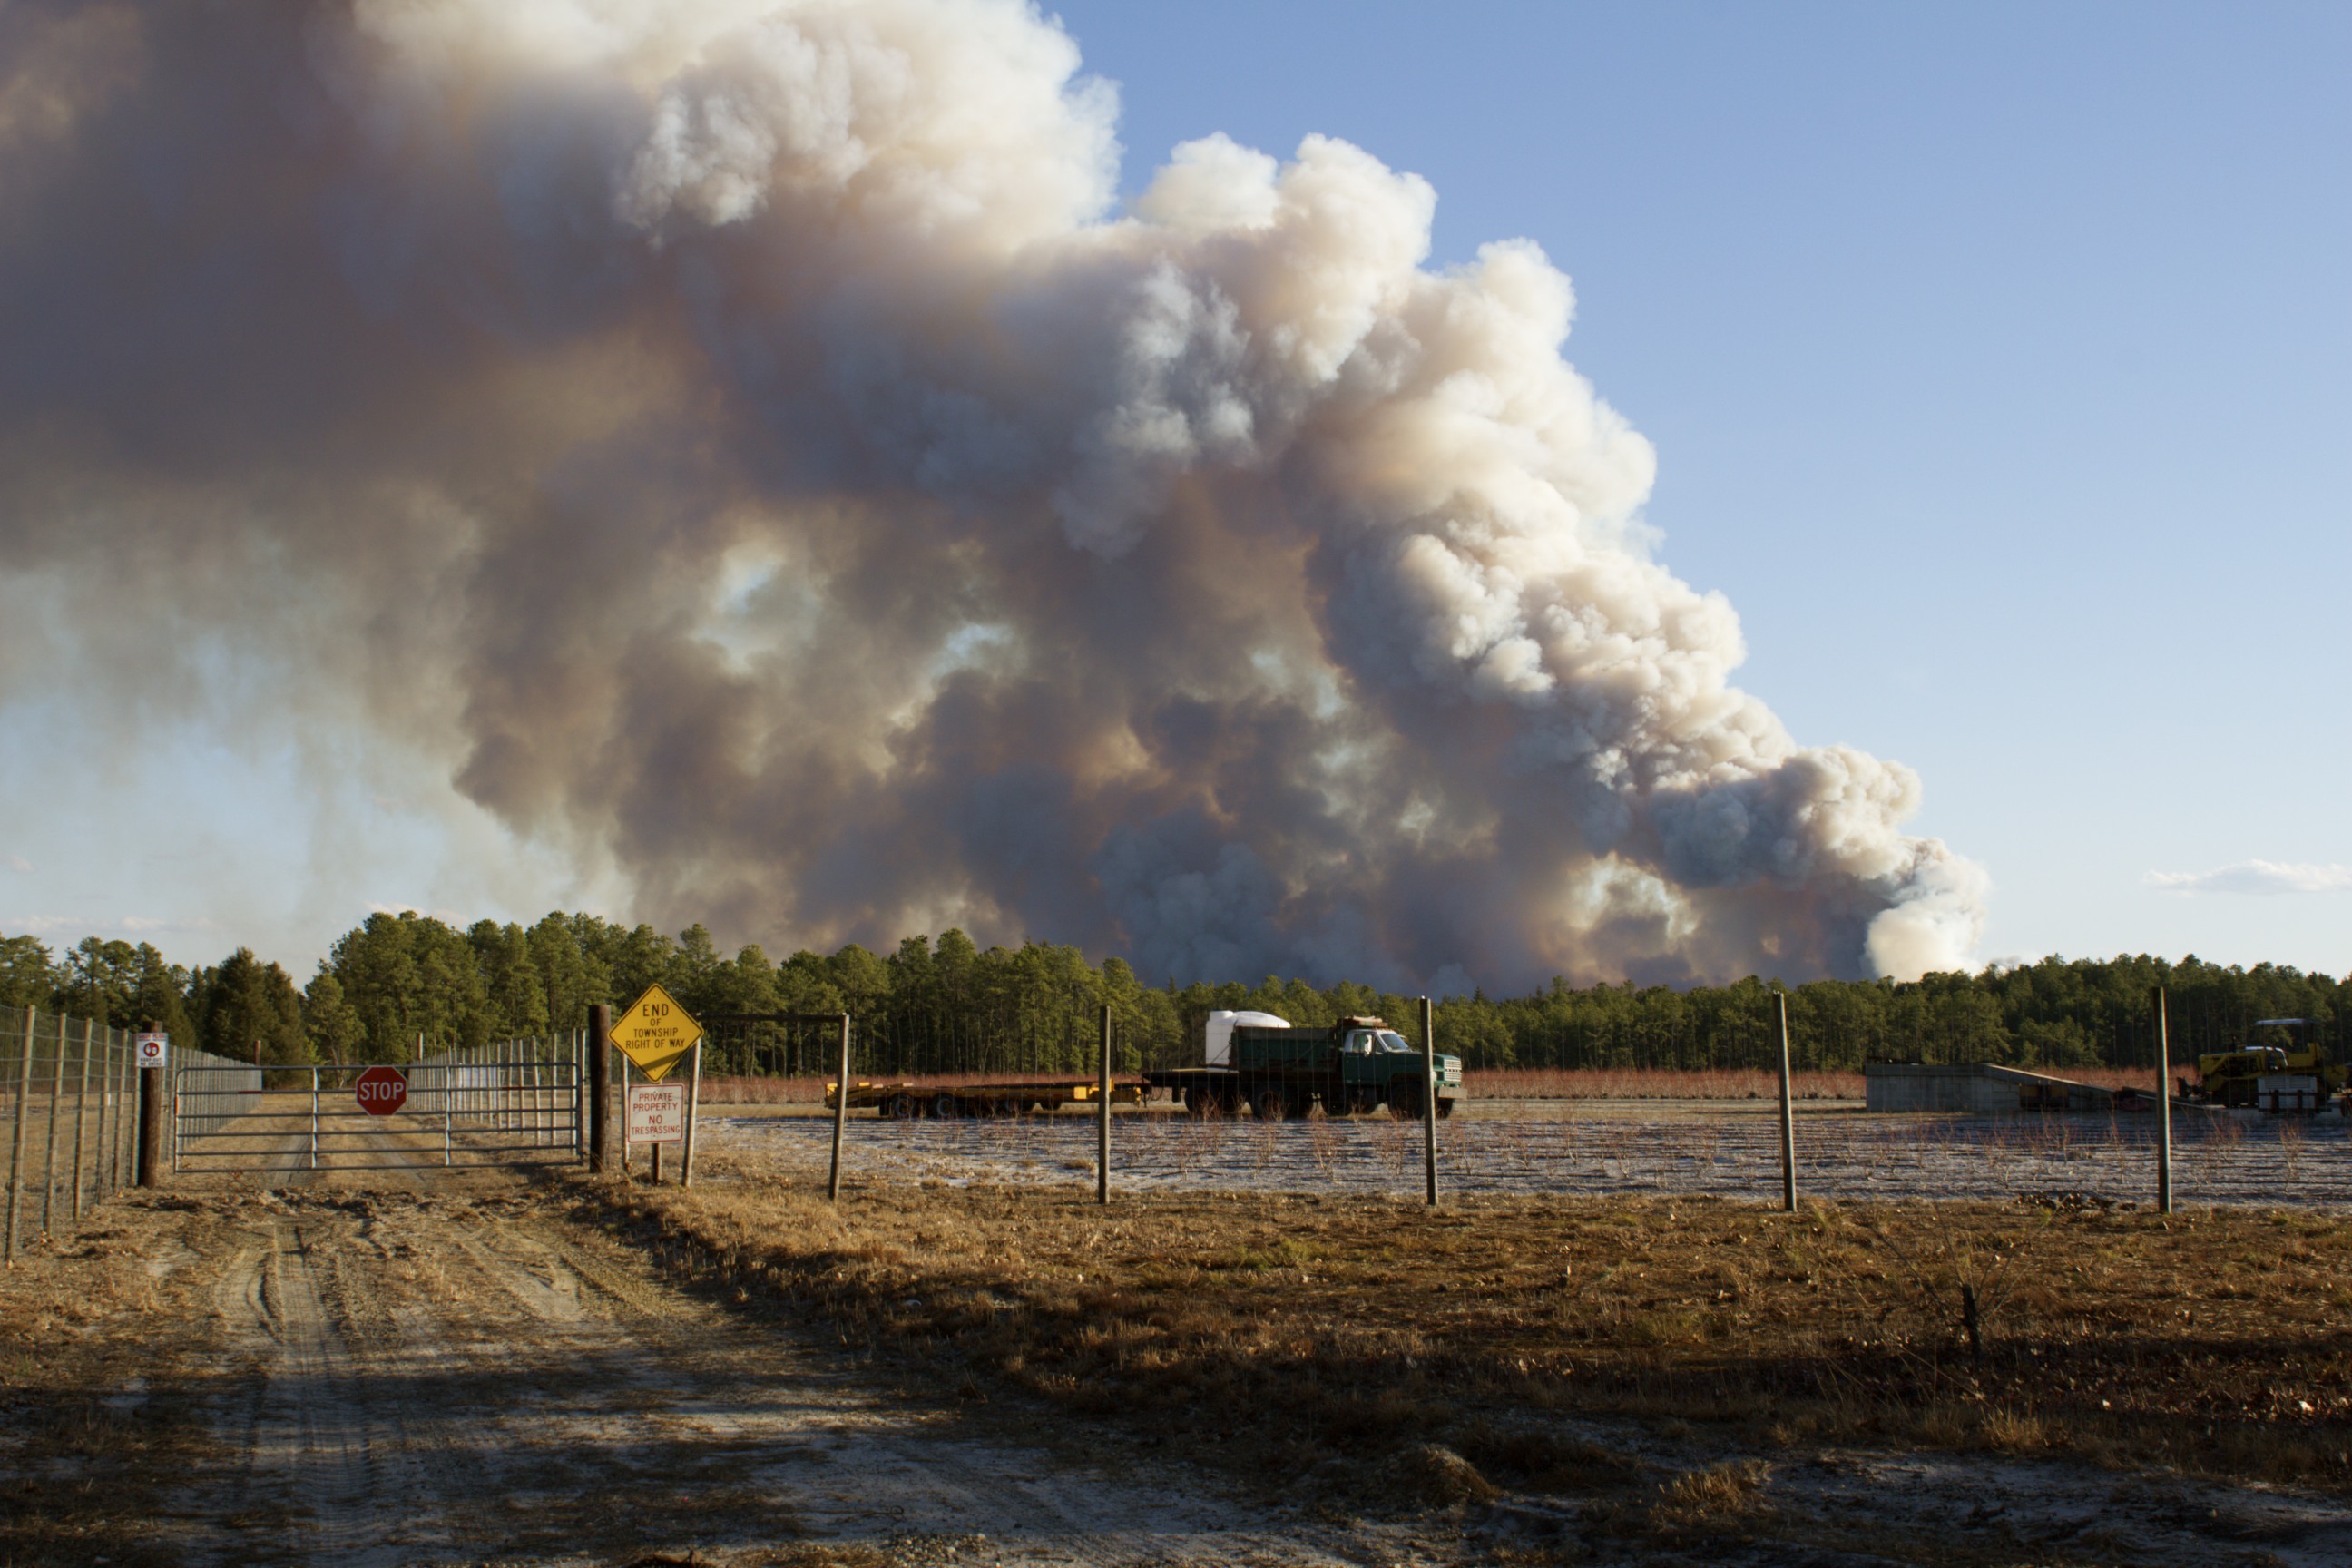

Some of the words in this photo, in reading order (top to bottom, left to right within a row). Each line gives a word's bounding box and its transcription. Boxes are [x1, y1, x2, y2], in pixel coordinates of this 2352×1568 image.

[643, 1004, 669, 1016] END
[650, 1018, 662, 1026] OF
[633, 1027, 679, 1038] TOWNSHIP
[625, 1039, 651, 1050] RIGHT
[654, 1039, 665, 1048] OF
[670, 1038, 685, 1047] WAY
[359, 1082, 405, 1101] STOP
[639, 1093, 673, 1102] PRIVATE
[632, 1102, 679, 1112] PROPERTY
[649, 1114, 663, 1124] NO
[632, 1124, 681, 1135] TRESPASSING
